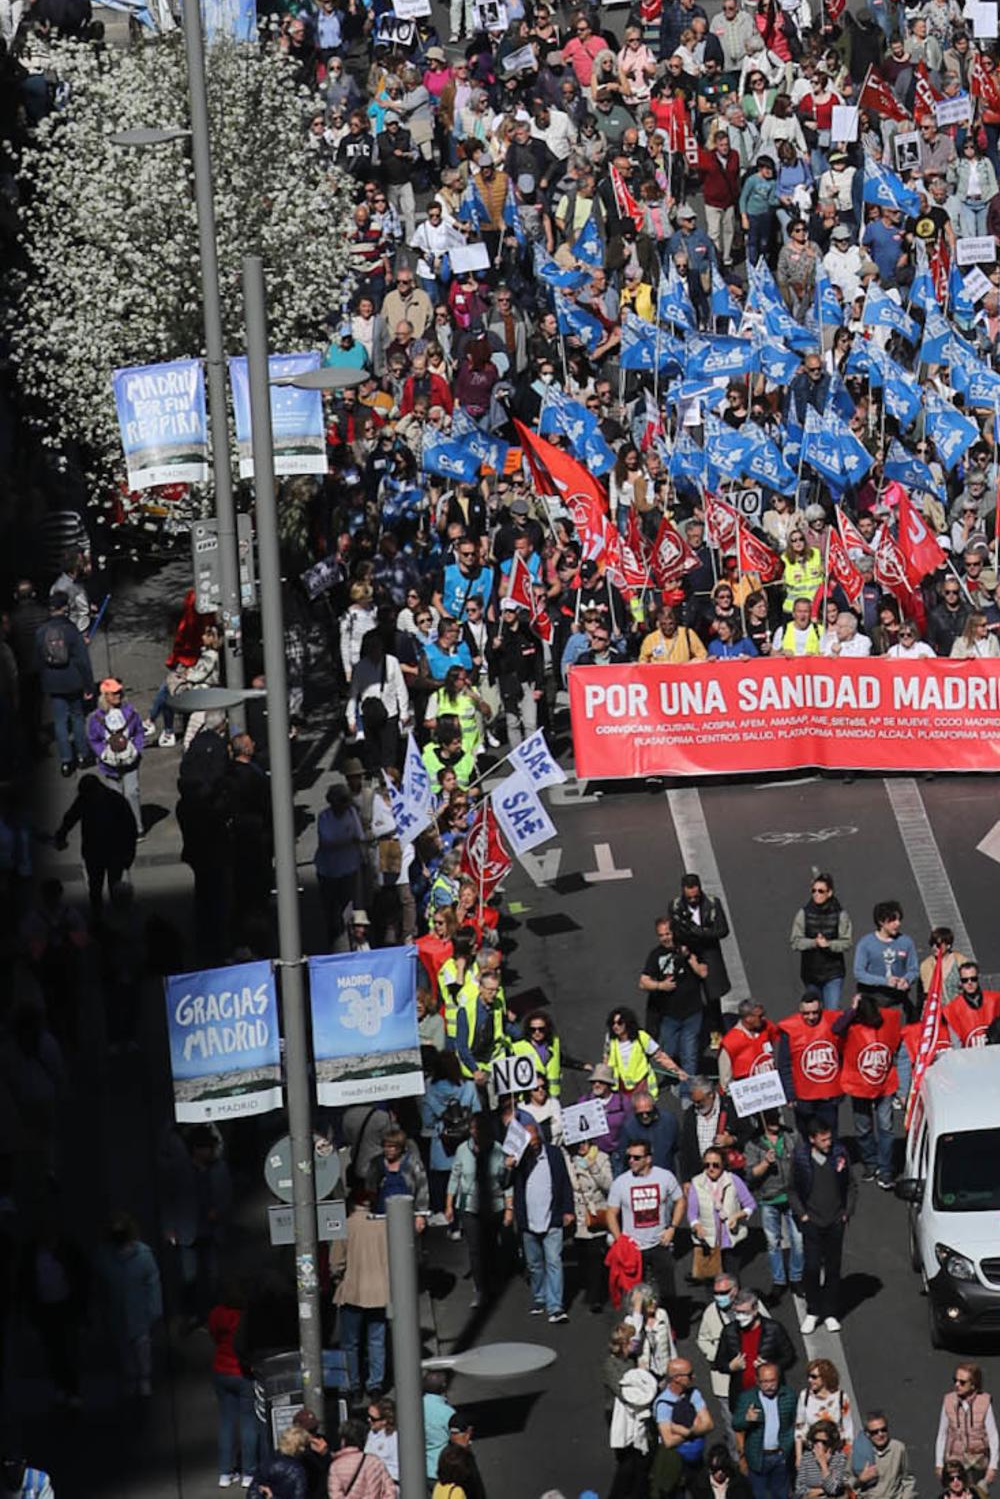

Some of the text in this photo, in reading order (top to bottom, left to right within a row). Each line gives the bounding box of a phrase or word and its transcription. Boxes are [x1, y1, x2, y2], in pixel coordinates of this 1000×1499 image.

[382, 19, 408, 40] NO
[126, 367, 199, 404] MADRID
[127, 411, 200, 445] RESPIRA
[584, 684, 649, 719] POR
[659, 679, 728, 717] UNA
[737, 675, 881, 712] SANIDAD
[337, 974, 373, 989] MADRID
[175, 983, 269, 1028] GRACIAS
[182, 1018, 268, 1062] MADRID
[806, 1047, 834, 1066] UGT
[861, 1049, 888, 1068] UGT
[492, 1056, 534, 1097] NO
[217, 1098, 259, 1113] MADRID
